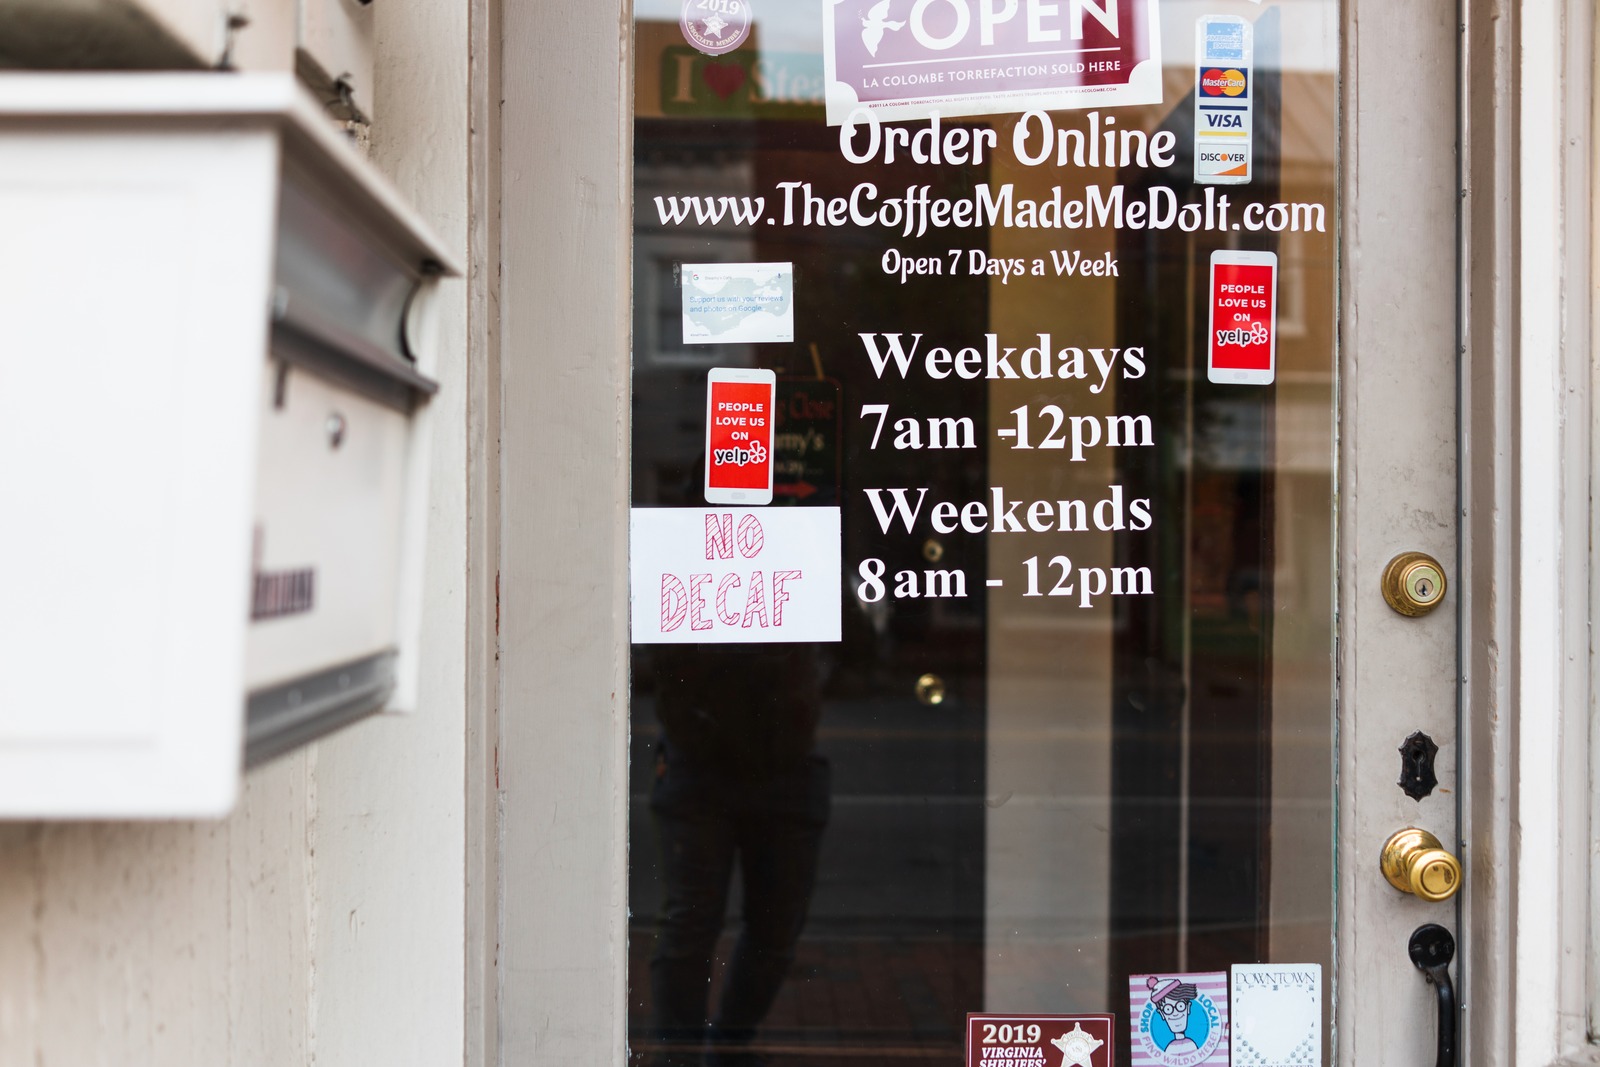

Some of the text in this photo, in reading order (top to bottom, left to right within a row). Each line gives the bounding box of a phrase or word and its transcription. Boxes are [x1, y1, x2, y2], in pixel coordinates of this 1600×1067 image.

[697, 0, 742, 16] 2019
[686, 21, 741, 47] ASSOCIATE MEMBER
[909, 0, 1119, 51] OPEN
[863, 60, 1121, 88] LA COLOMBE TORREFACTION SOLD HERE
[1202, 78, 1246, 88] MasterCard
[1204, 114, 1243, 128] VISA
[838, 111, 1176, 168] Order Online
[1201, 153, 1245, 162] DISCOVER
[653, 181, 1327, 237] www.TheCoffeeMadeMeDoIt.com
[880, 250, 1120, 283] Open 7 Days a Week
[1220, 284, 1265, 295] PEOPLE
[689, 296, 716, 304] Support
[1218, 298, 1267, 308] LOVE US
[1233, 313, 1251, 322] ON
[1217, 329, 1251, 346] yelp
[858, 333, 1147, 394] Weekdays
[718, 402, 764, 413] PEOPLE
[716, 417, 765, 427] LOVE US
[860, 404, 977, 450] 7am
[731, 431, 749, 440] ON
[715, 447, 749, 465] yelp
[863, 485, 1153, 535] Weekends
[705, 514, 764, 560] NO
[856, 556, 1155, 608] 8am - 12pm
[661, 570, 803, 633] DECAF
[1235, 972, 1315, 984] DOWNTOWN
[1140, 994, 1219, 1033] SHOP LOCAL
[982, 1023, 1042, 1044] 2019
[981, 1046, 1044, 1058] VIRGINIA
[1142, 1032, 1219, 1066] FIND WALDO HERE!
